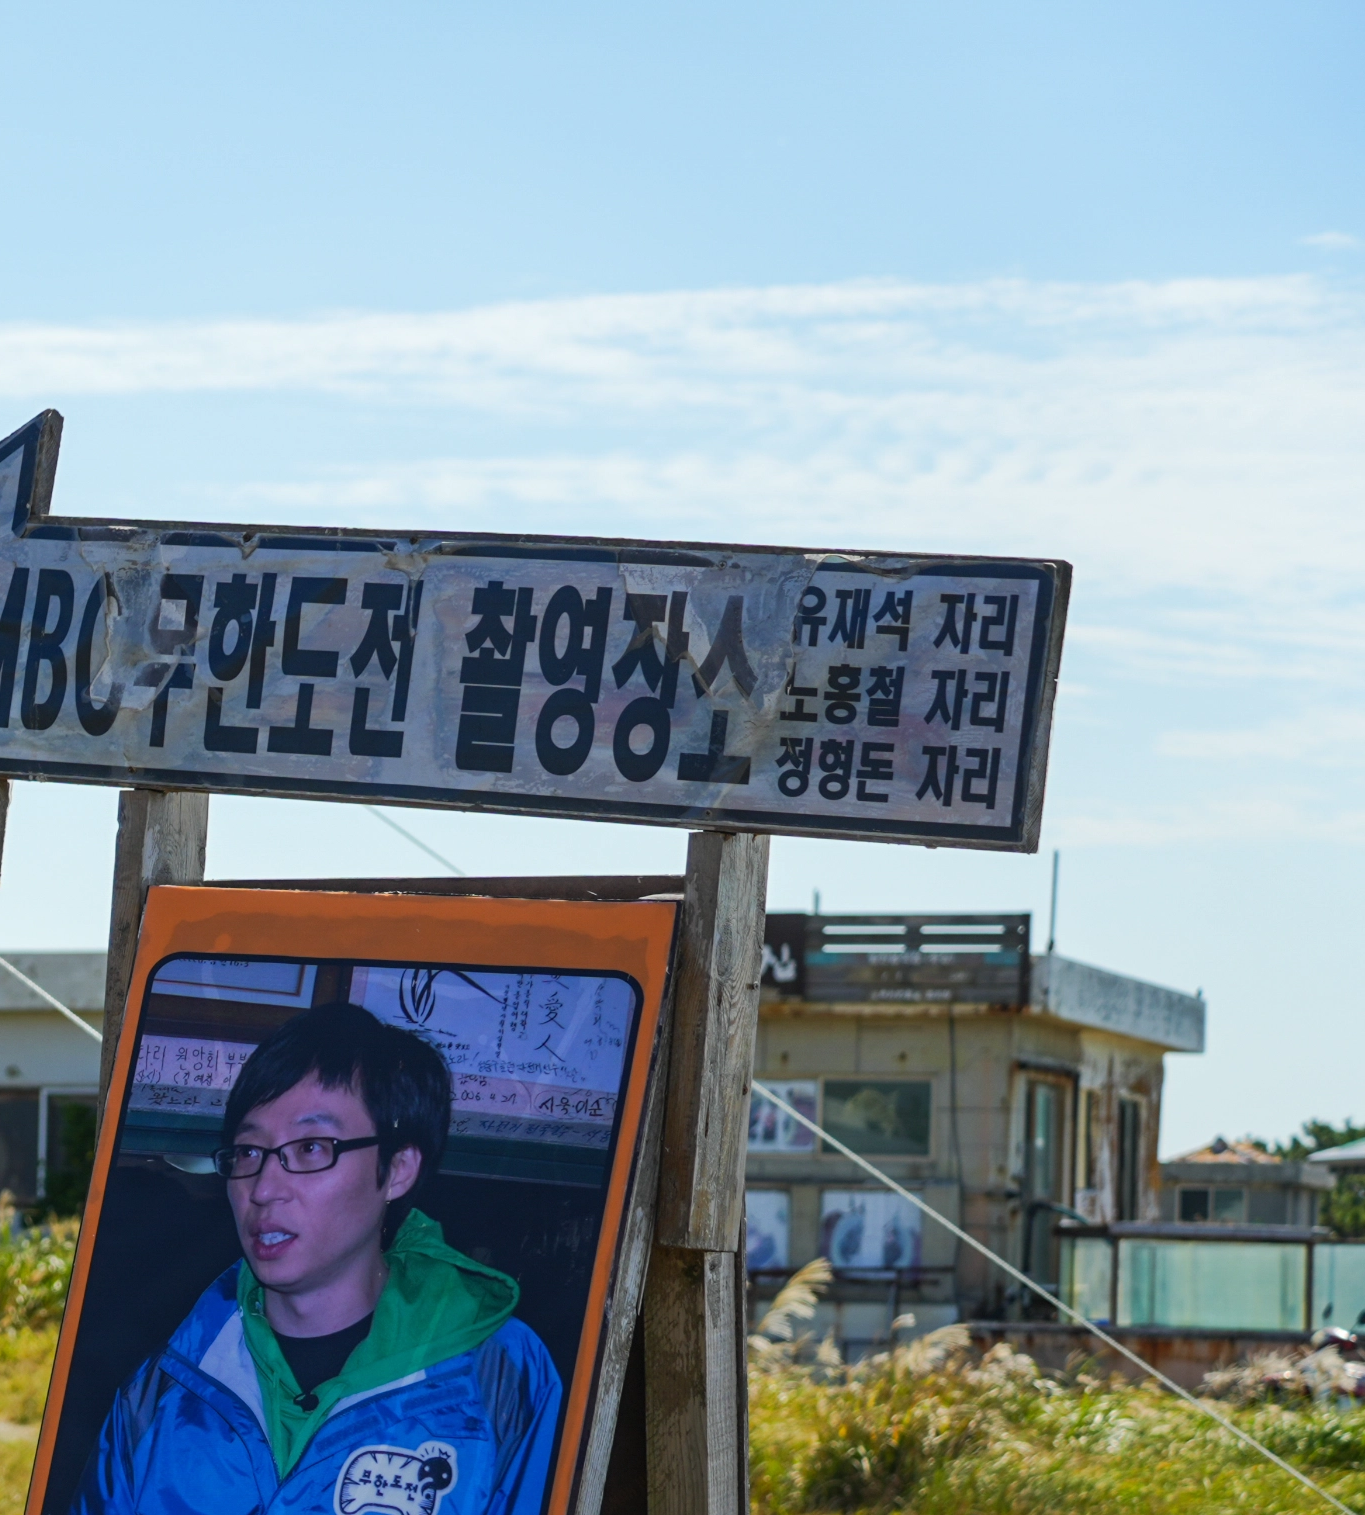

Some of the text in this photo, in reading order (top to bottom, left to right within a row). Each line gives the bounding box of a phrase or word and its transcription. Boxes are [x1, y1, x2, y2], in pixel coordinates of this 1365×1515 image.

[795, 585, 1020, 657] 유재석 자리
[132, 572, 424, 759] 무한도전
[455, 580, 759, 785] 촬영장소
[779, 661, 1010, 733] 노홍철 자리
[775, 736, 1001, 810] 정형돈 자리
[359, 1469, 419, 1502] 무한도전
